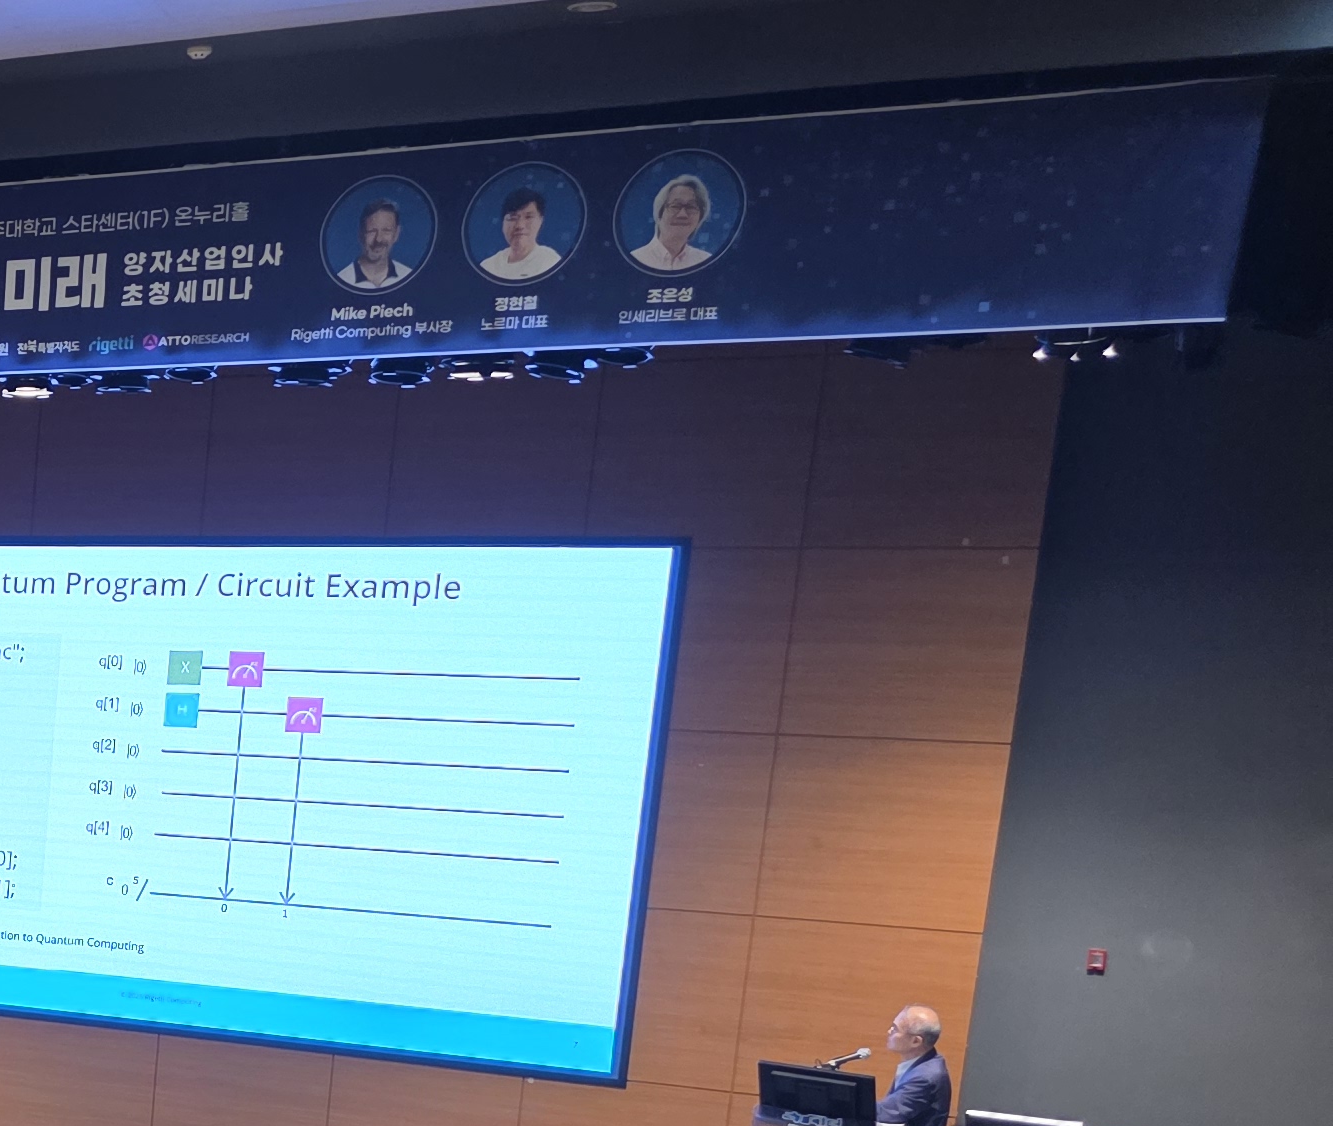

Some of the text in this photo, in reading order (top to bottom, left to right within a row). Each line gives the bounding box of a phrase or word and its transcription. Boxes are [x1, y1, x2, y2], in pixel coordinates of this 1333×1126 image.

[62, 207, 169, 235] 스타센터(1F)
[174, 201, 249, 226] 온누리홀
[123, 241, 284, 276] 양자산업인사
[5, 253, 107, 310] 미래
[120, 275, 252, 307] 초청세미나
[331, 303, 413, 321] Mike Piech
[481, 313, 549, 331] 노르마 대표
[690, 306, 718, 322] 대표
[291, 326, 333, 343] Rigetti
[335, 323, 411, 340] Computing
[88, 335, 134, 355] rigetti
[66, 572, 185, 603] Program
[219, 571, 315, 598] Circuit
[327, 572, 460, 607] Example
[23, 933, 33, 943] to
[36, 933, 83, 947] Quantum
[87, 937, 144, 955] Computing
